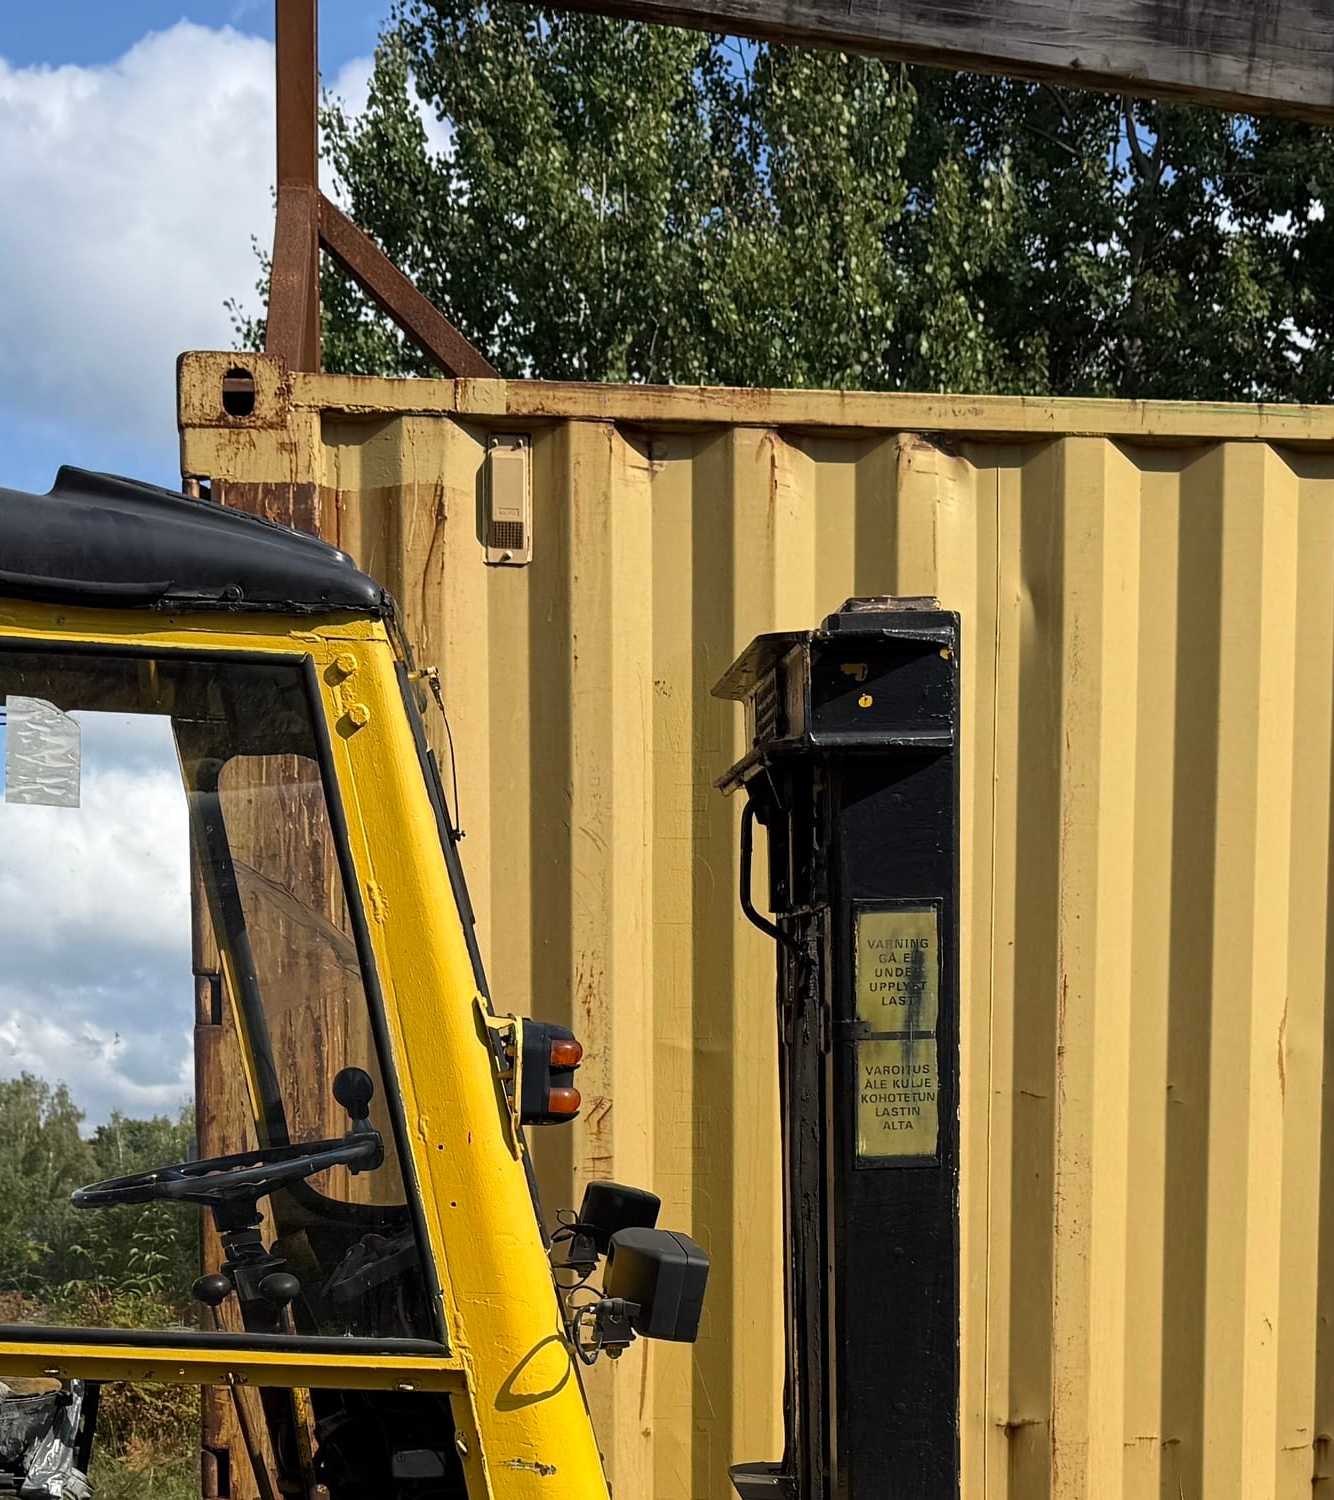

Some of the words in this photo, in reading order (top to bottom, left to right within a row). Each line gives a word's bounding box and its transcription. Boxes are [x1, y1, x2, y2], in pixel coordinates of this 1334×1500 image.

[867, 938, 929, 950] VARNING
[878, 952, 898, 964] GÅ
[874, 967, 919, 978] UNDE
[881, 996, 916, 1006] LAST
[865, 1064, 930, 1076] VAROITUS
[892, 1077, 932, 1089] KULJE
[860, 1092, 935, 1104] KOHOTETUN
[875, 1106, 920, 1117] LASTIN
[882, 1120, 914, 1131] ALTA
